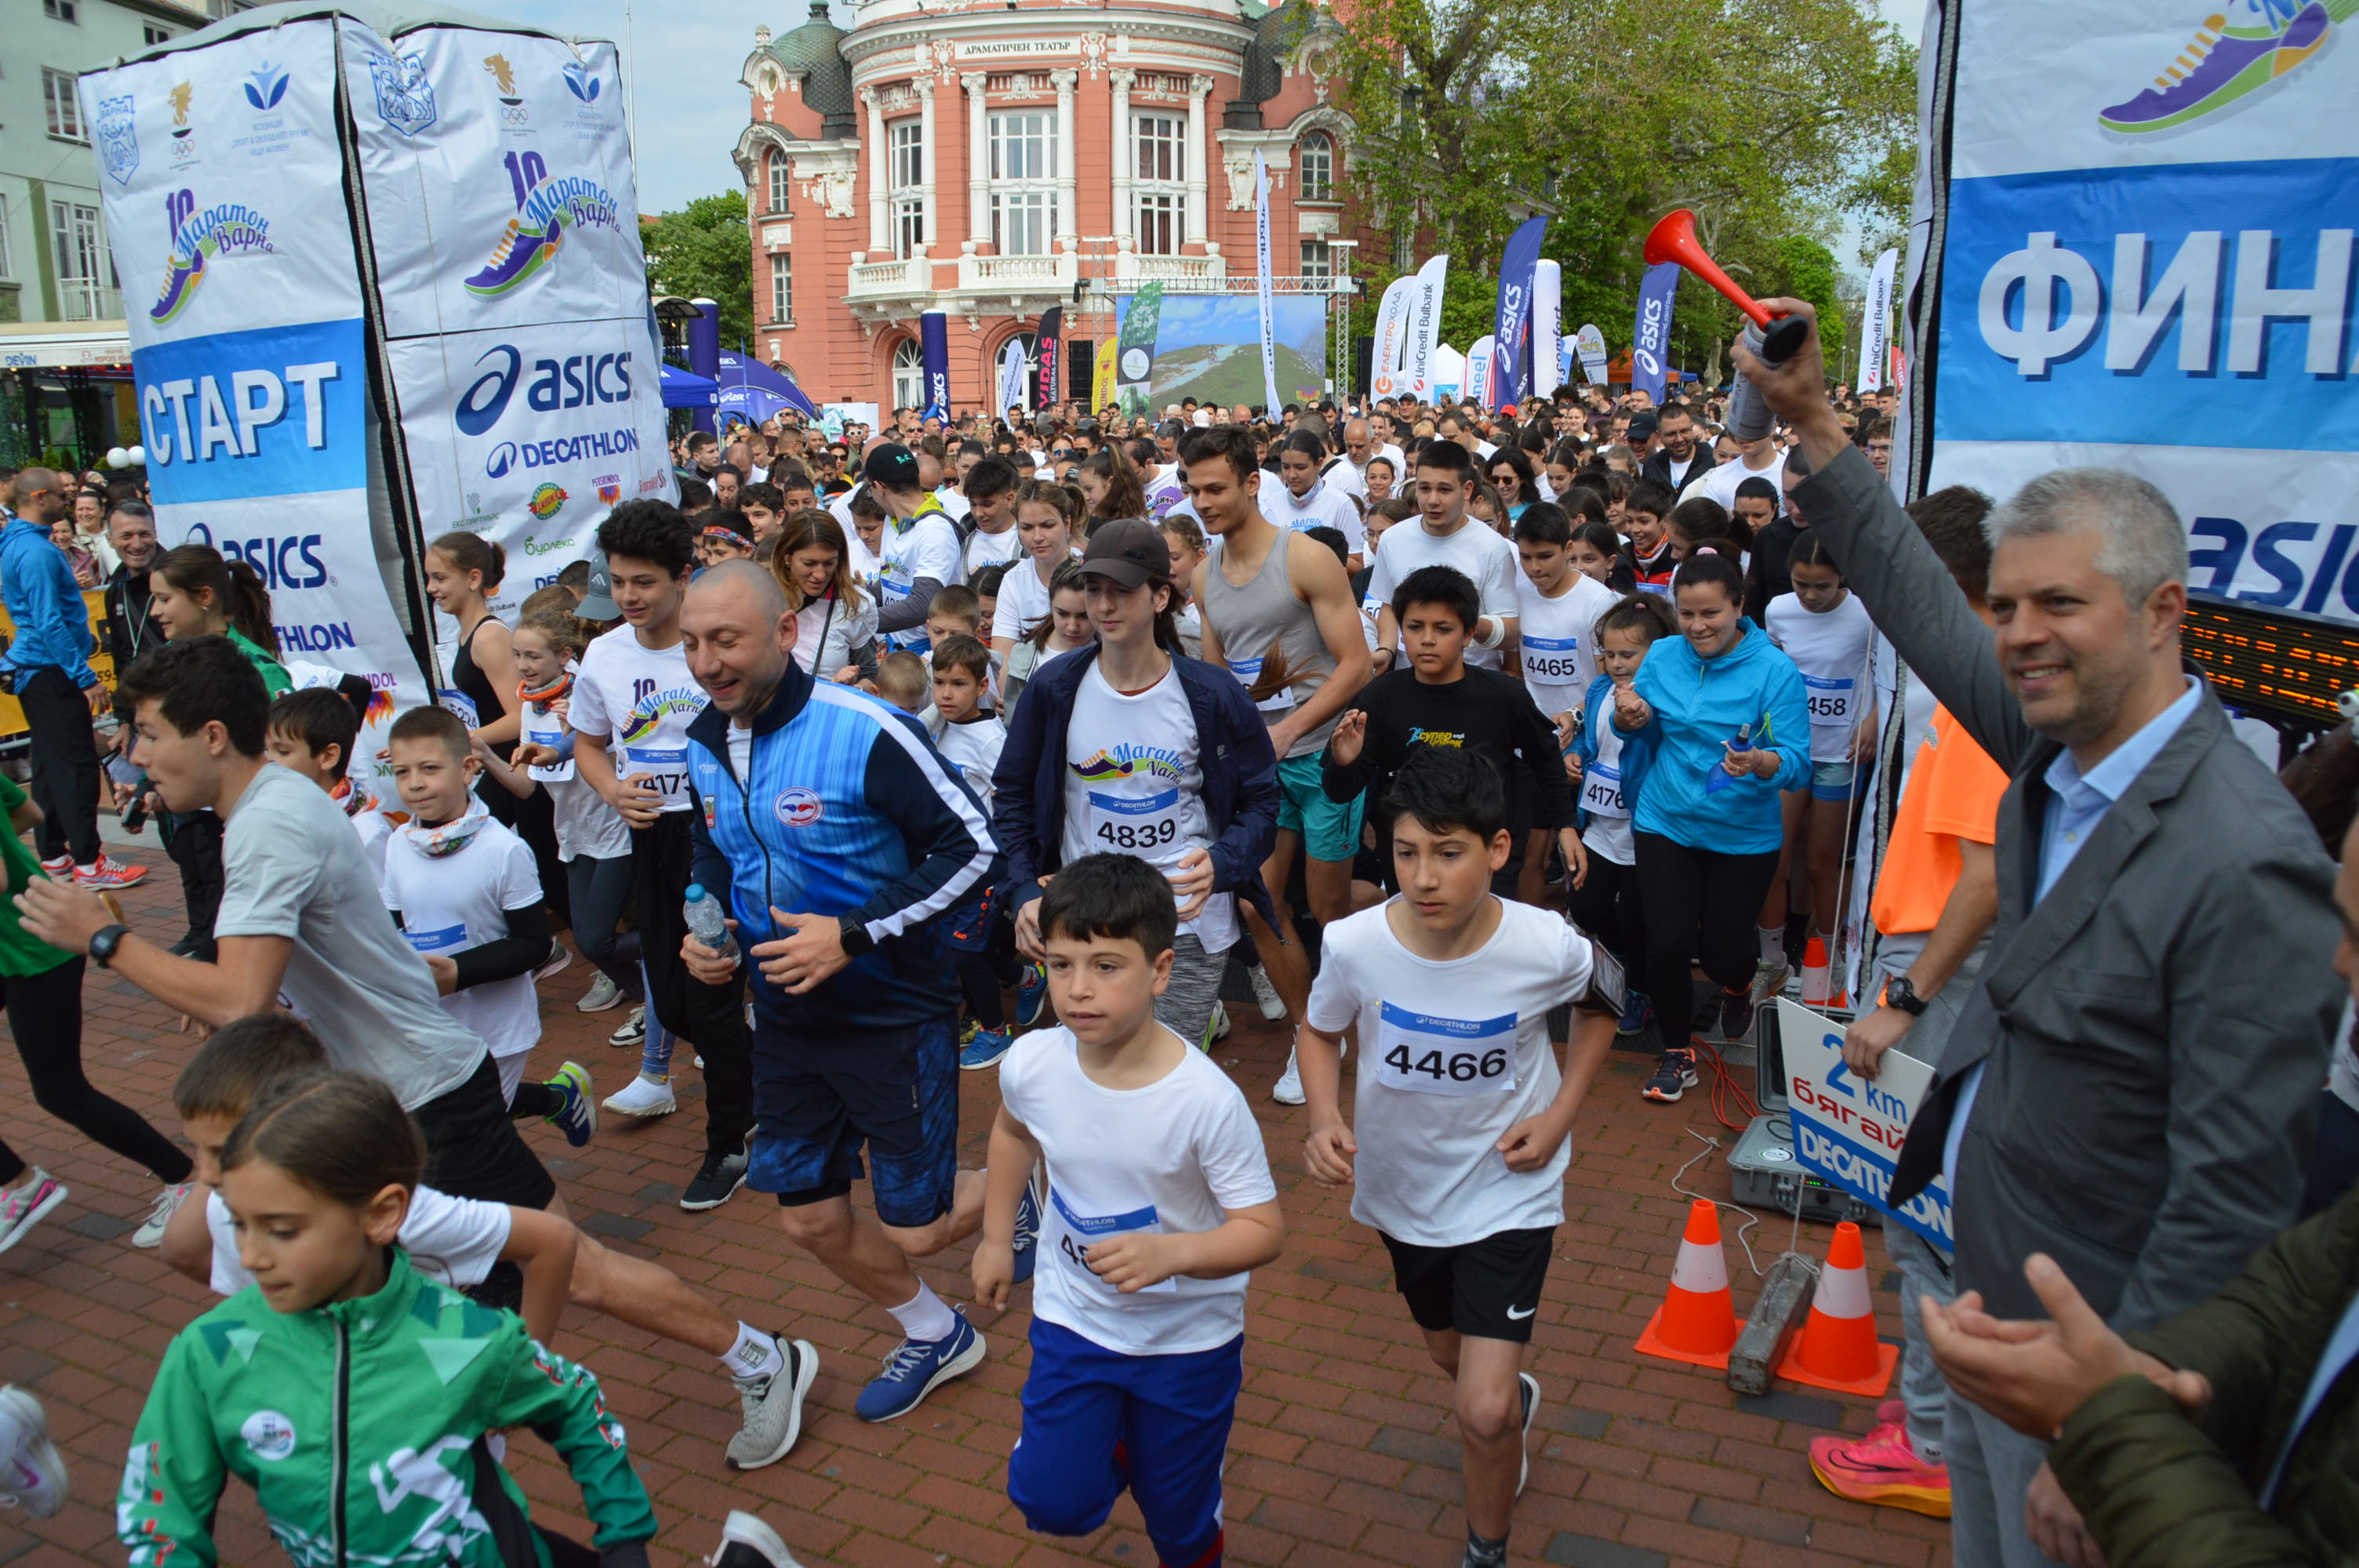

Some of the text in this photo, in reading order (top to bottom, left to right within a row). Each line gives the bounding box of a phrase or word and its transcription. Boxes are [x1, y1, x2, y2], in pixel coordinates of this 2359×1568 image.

[965, 41, 1070, 55] ДРАМАТИЧЕН ТЕАТЪР
[503, 151, 547, 216] 10
[165, 188, 194, 251] 10
[177, 204, 269, 264] Маратон
[213, 225, 274, 255] Варна
[1978, 229, 2359, 375] ФИН
[1415, 283, 1434, 378] UniCredit Bulbank
[1870, 277, 1885, 370] UniCredit Bulbank
[5, 353, 37, 366] DEVIN
[1039, 337, 1053, 408] VIDAS
[1100, 377, 1109, 408] KINDOL
[144, 361, 340, 466] СТАРТ
[522, 427, 639, 468] DECATHLON
[272, 622, 356, 652] THLON
[1527, 655, 1575, 676] 4465
[638, 687, 706, 716] Marathon
[1807, 696, 1846, 716] 458
[1113, 742, 1185, 776] Marathon
[1147, 760, 1181, 785] Varna
[1120, 799, 1156, 808] DECATHLON
[1097, 818, 1176, 848] 4839
[1429, 1018, 1481, 1030] DECATHLON
[1385, 1044, 1507, 1081] 4466
[1865, 1080, 1907, 1125] km
